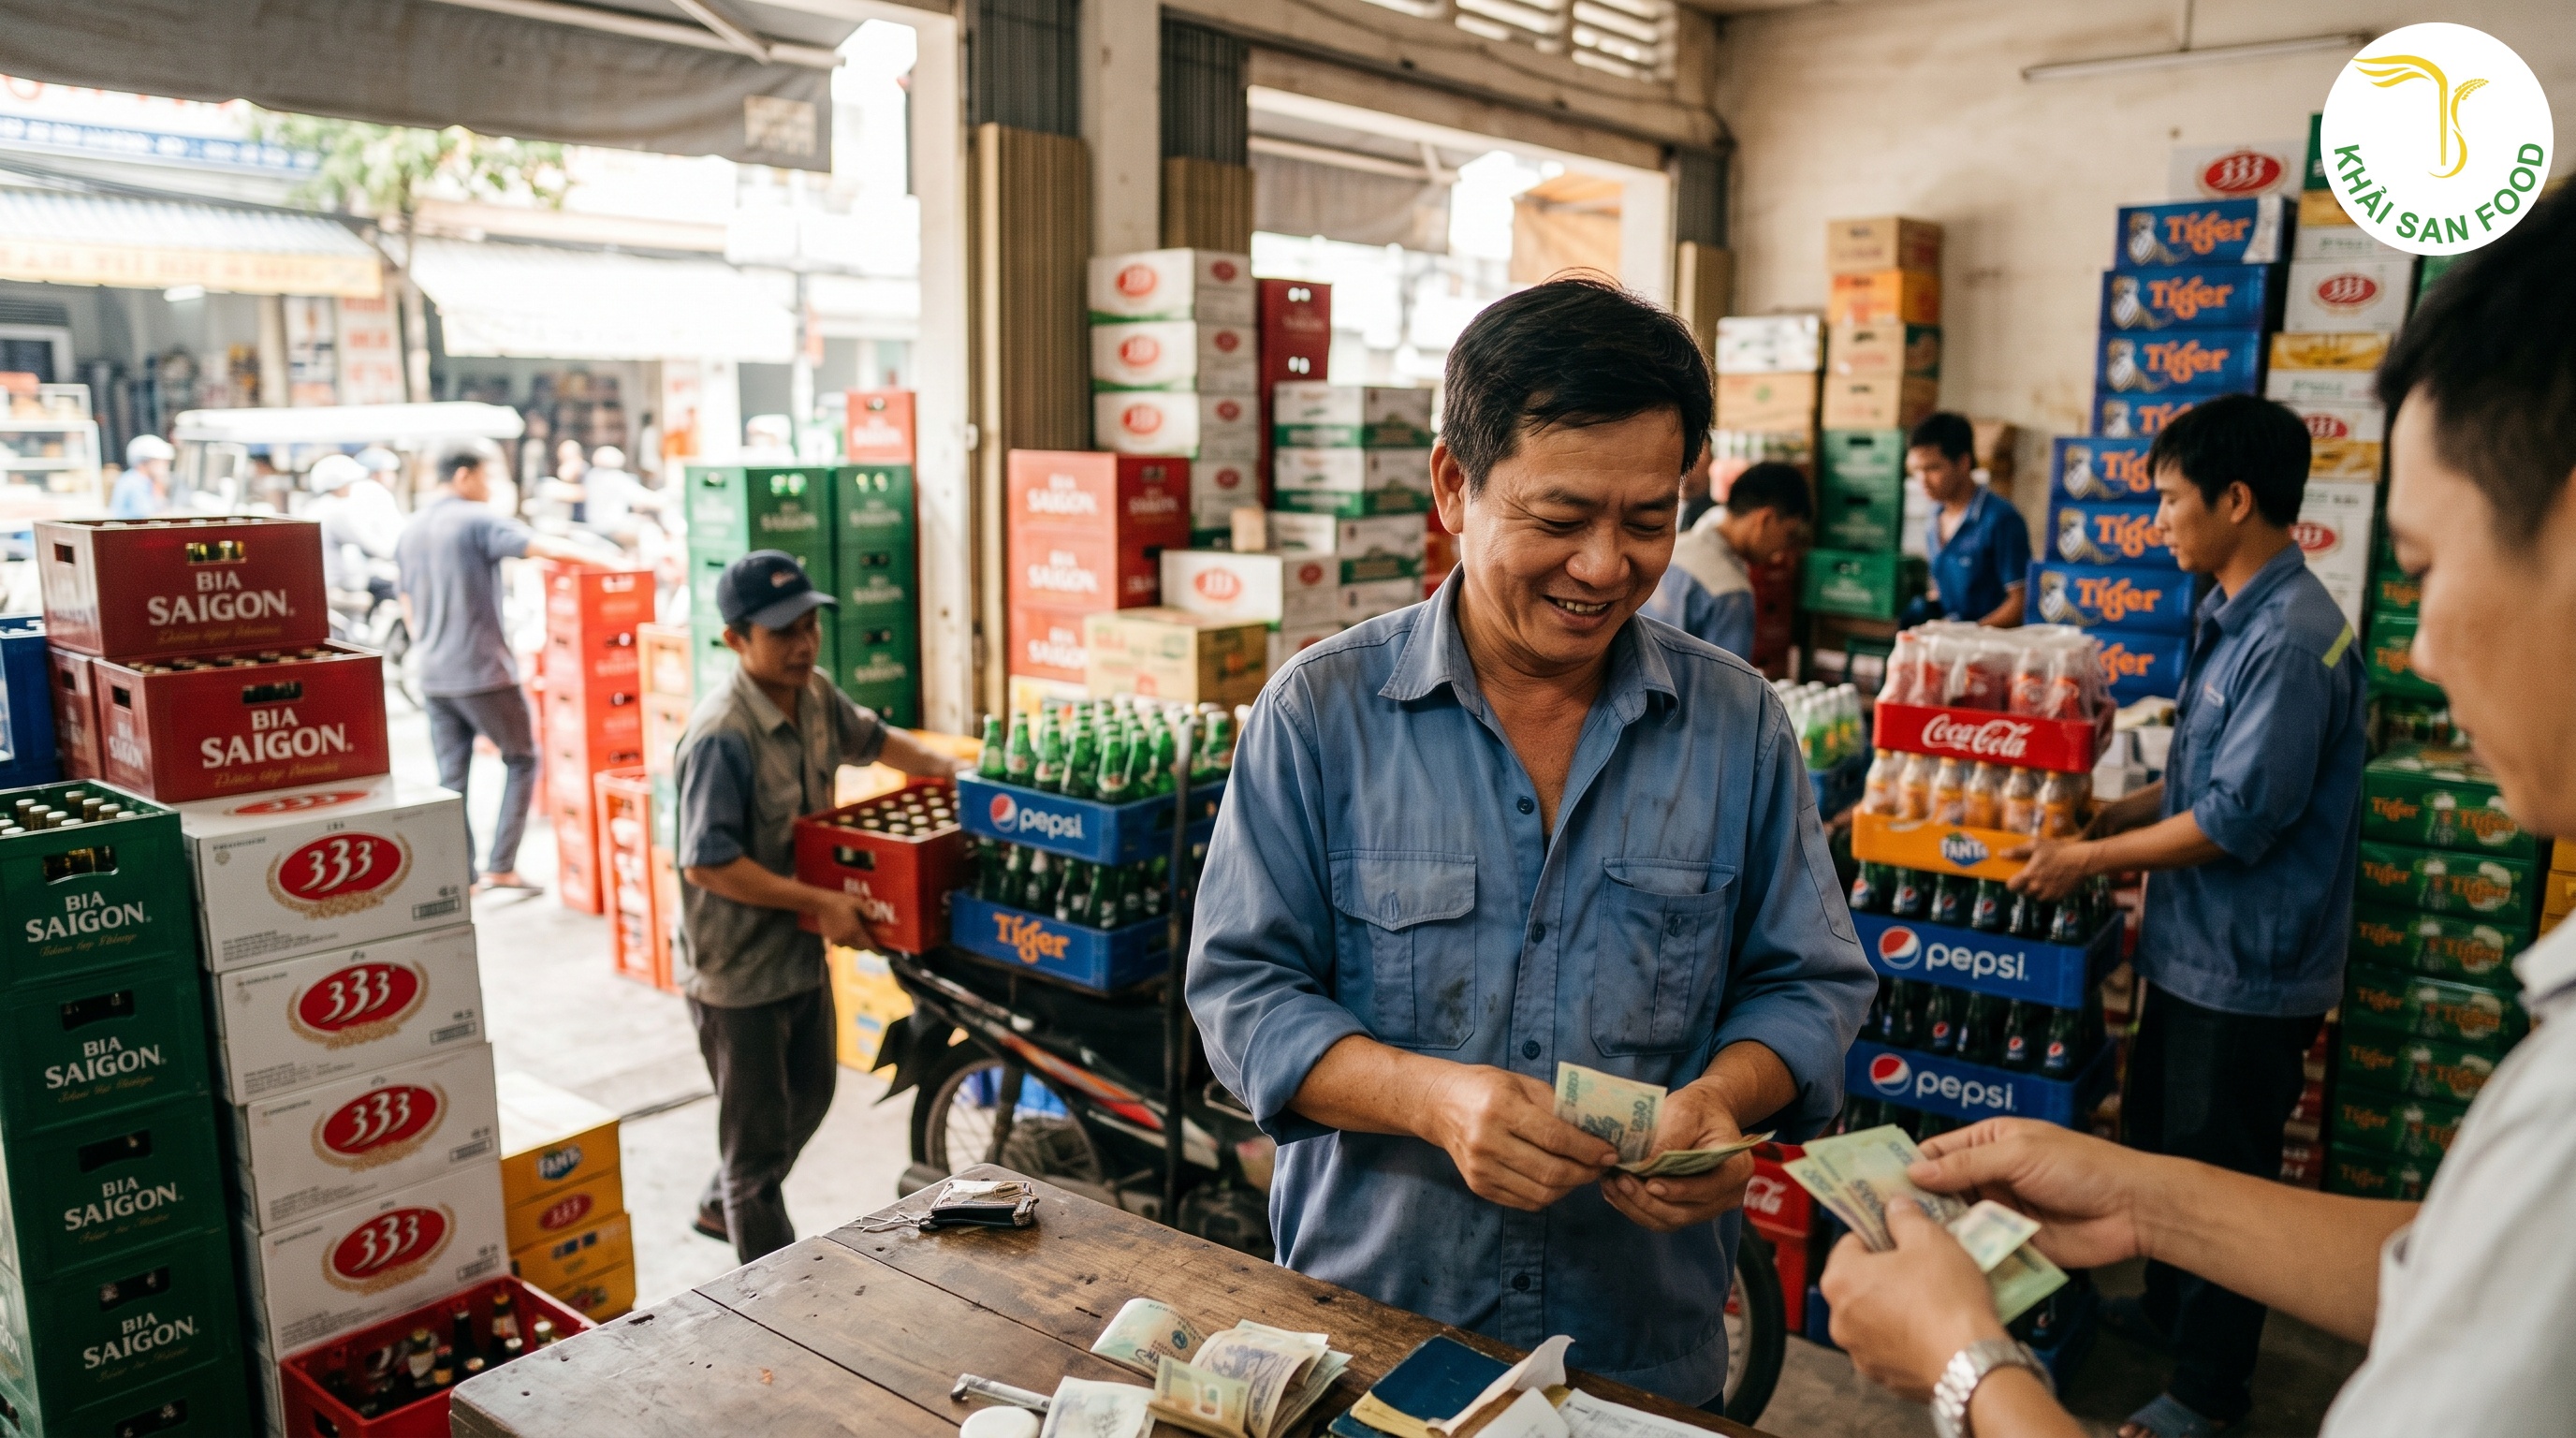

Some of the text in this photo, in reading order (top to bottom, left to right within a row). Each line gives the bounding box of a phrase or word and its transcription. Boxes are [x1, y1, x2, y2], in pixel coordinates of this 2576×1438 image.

[2214, 154, 2265, 189] 333
[2164, 210, 2251, 255] Tiger
[2148, 275, 2234, 318] Tiger
[2325, 278, 2364, 302] 333
[2143, 339, 2230, 384] Tiger
[2100, 449, 2152, 493] Tig
[2094, 513, 2166, 558] Tige
[196, 571, 242, 592] BIA
[2075, 577, 2163, 622] Tiger
[148, 589, 289, 627] SAIGON
[2097, 640, 2156, 685] ger
[251, 707, 300, 731] BIA
[201, 722, 346, 770] SAIGON
[1019, 807, 1083, 840] pepsi
[299, 838, 373, 894] 333
[25, 901, 145, 943] SAIGON
[65, 890, 106, 913] BIA
[992, 912, 1071, 964] Tiger
[1925, 942, 2027, 981] pepsi
[317, 967, 392, 1024] 333
[44, 1043, 162, 1090] SAIGON
[82, 1036, 124, 1059] BIA
[1915, 1070, 2014, 1111] pepsi
[340, 1091, 412, 1148] 333
[64, 1181, 178, 1231] SAIGON
[101, 1176, 140, 1199] BIA
[351, 1215, 420, 1273] 333
[82, 1314, 195, 1370] SAIGON
[121, 1312, 158, 1335] BIA
